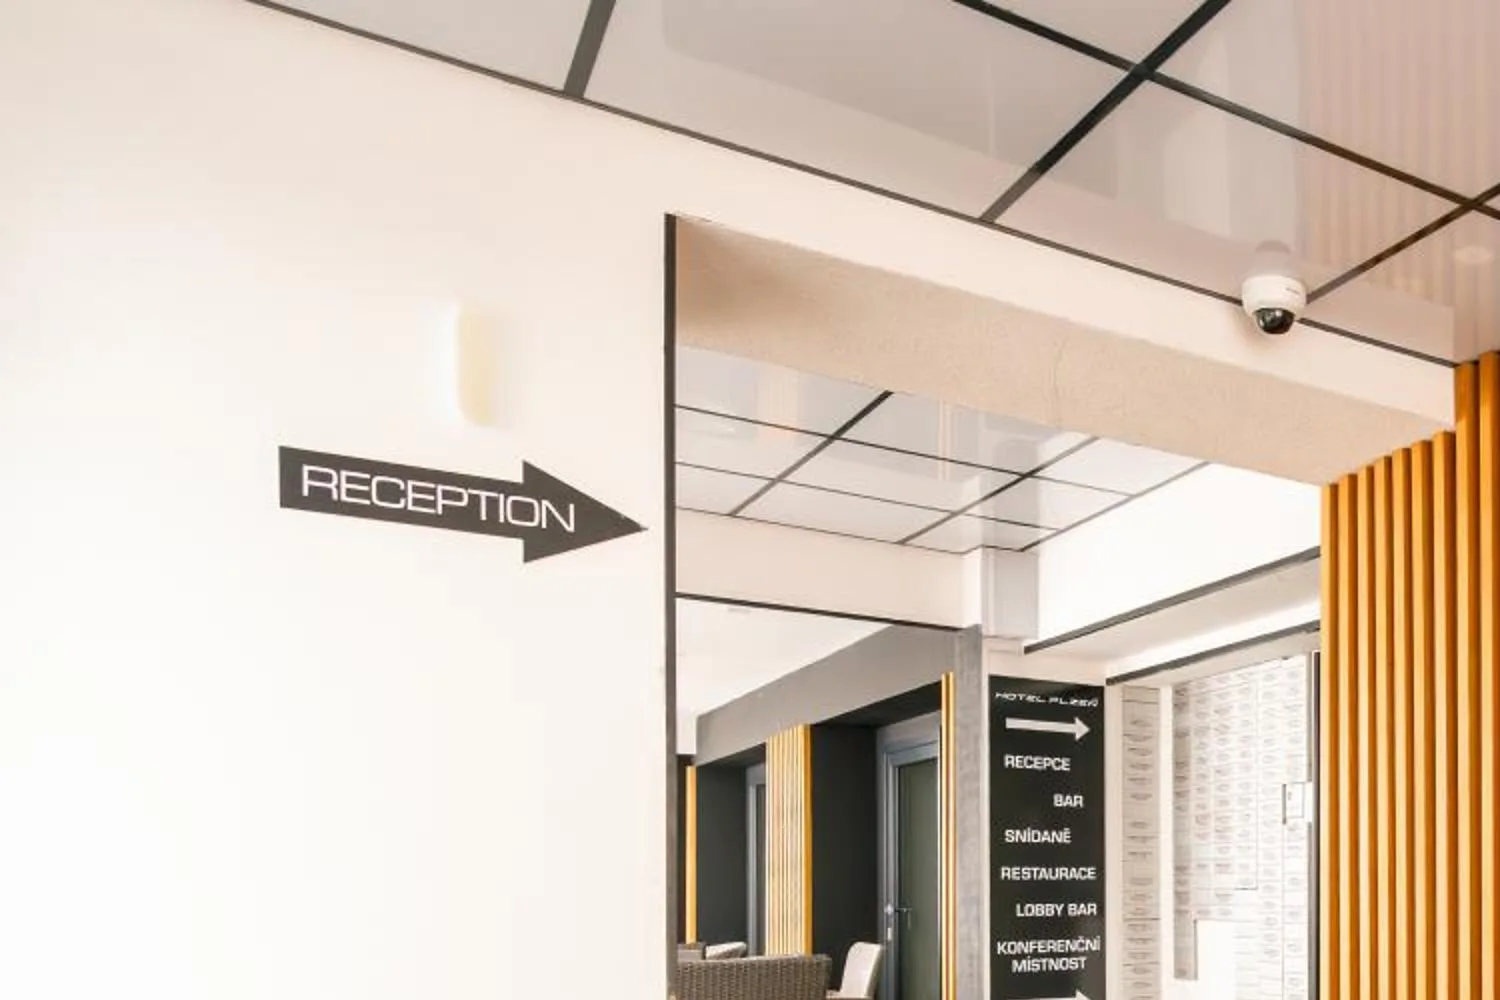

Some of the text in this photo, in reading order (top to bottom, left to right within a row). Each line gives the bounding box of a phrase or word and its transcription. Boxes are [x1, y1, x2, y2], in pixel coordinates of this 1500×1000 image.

[302, 464, 575, 533] RECEPTION
[995, 692, 1046, 703] HOTEL
[1004, 755, 1071, 771] RECEPCE
[1053, 793, 1084, 808] BAR
[1000, 866, 1098, 881] RESTAURACE
[1015, 903, 1098, 918] LOBBY BAR
[996, 935, 1101, 956] KONFERENČNÍ
[1011, 955, 1088, 974] MÍSTNOST
